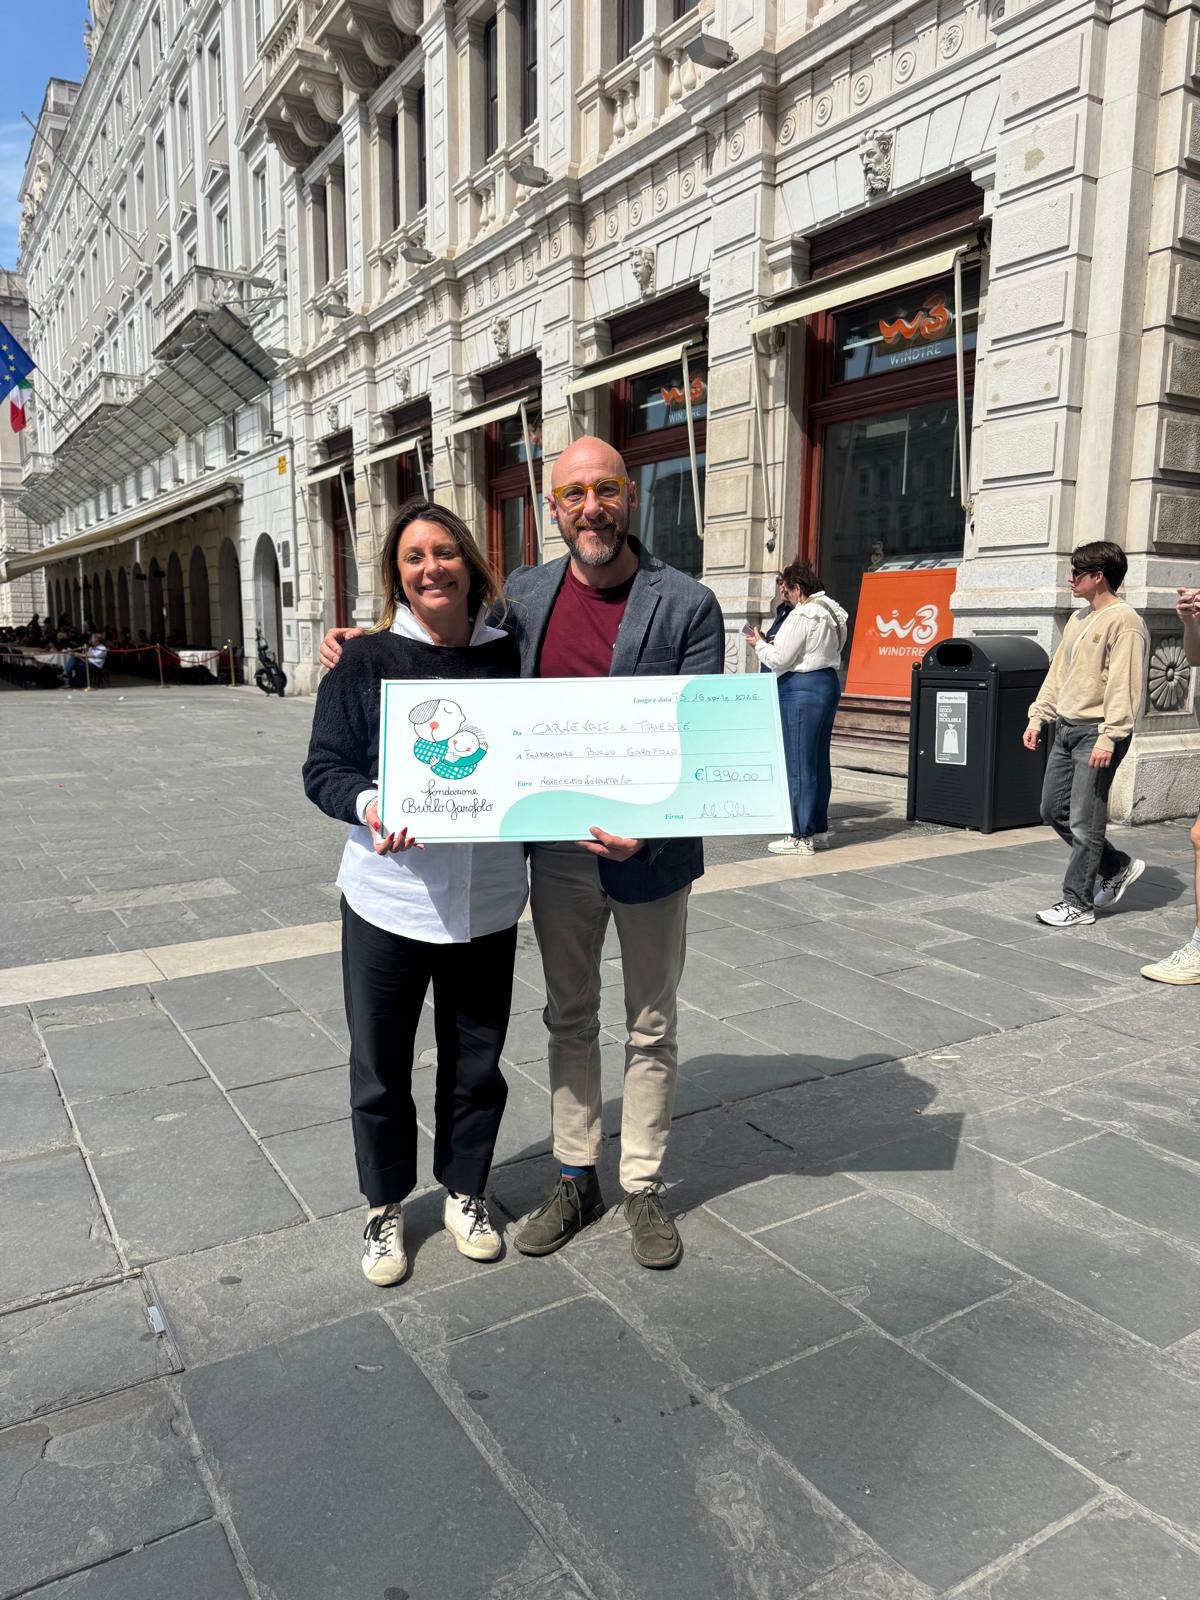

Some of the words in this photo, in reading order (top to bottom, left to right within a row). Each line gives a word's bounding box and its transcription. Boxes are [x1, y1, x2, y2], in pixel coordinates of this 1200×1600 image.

[890, 343, 942, 366] WINDTRE
[878, 646, 926, 657] WINDTRE
[635, 720, 690, 732] TRIESTE
